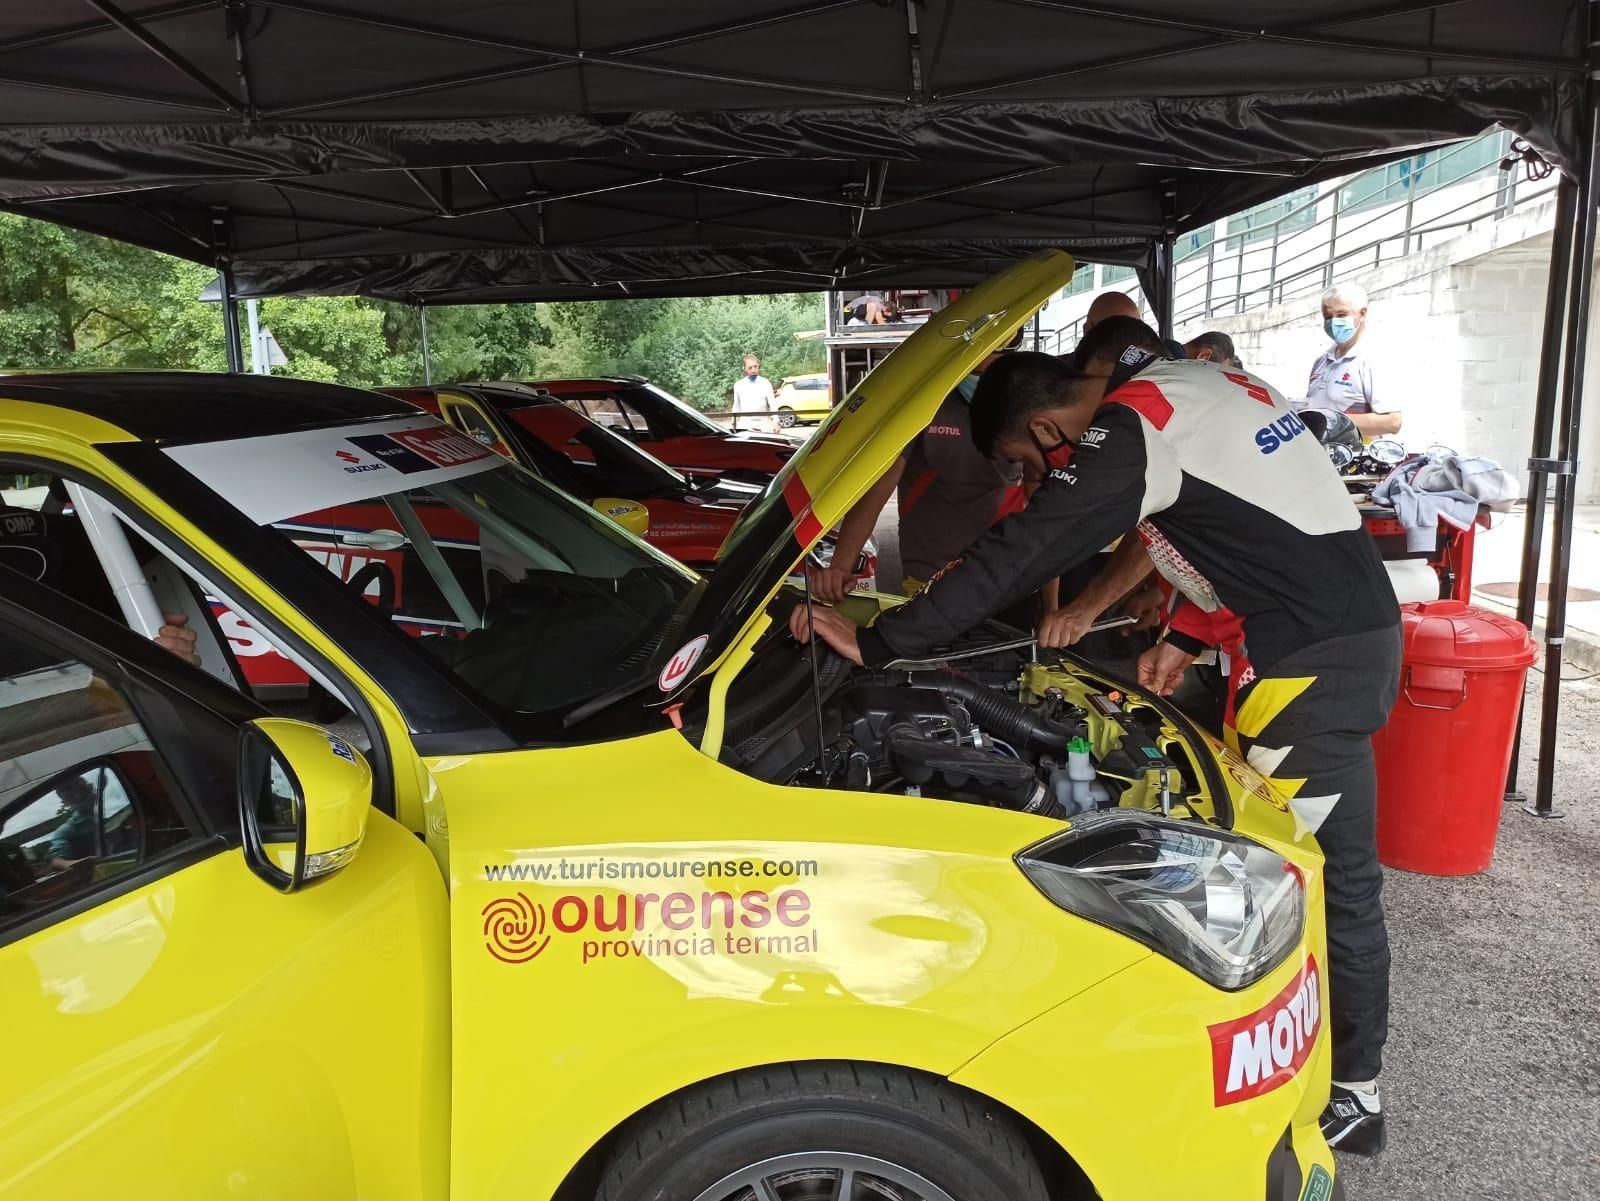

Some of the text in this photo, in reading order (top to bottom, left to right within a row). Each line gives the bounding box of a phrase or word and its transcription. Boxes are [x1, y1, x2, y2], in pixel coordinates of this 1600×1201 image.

[928, 425, 961, 436] MOTUL
[1081, 430, 1107, 444] OMP
[1255, 410, 1306, 455] SUZU
[343, 463, 387, 474] SUZUKI
[5, 516, 35, 534] OMP
[484, 857, 819, 882] www.turismourense.com
[551, 889, 812, 934] ourense
[582, 929, 818, 964] provincia termal
[1225, 970, 1320, 1094] MOTUL
